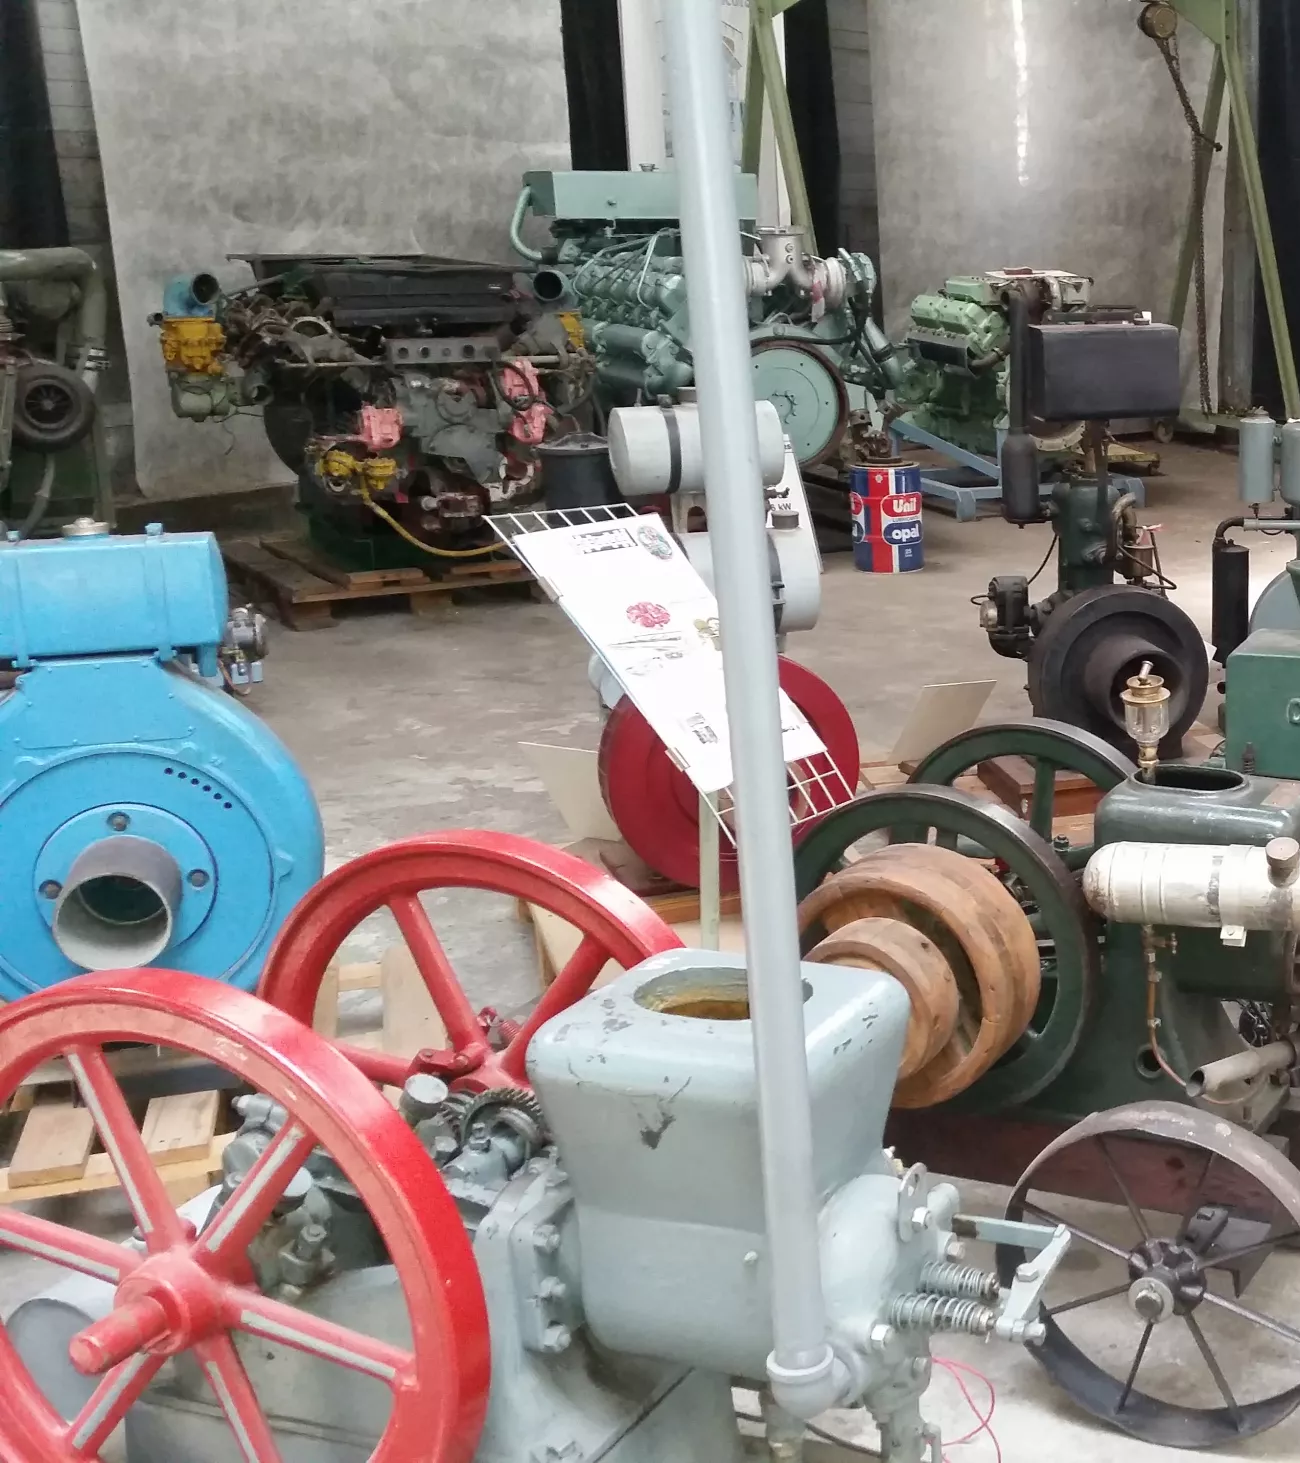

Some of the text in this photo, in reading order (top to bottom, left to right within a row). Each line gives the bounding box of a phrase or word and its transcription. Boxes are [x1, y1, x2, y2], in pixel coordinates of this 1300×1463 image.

[777, 502, 791, 511] kW
[892, 496, 916, 513] Unil
[891, 523, 920, 542] opal
